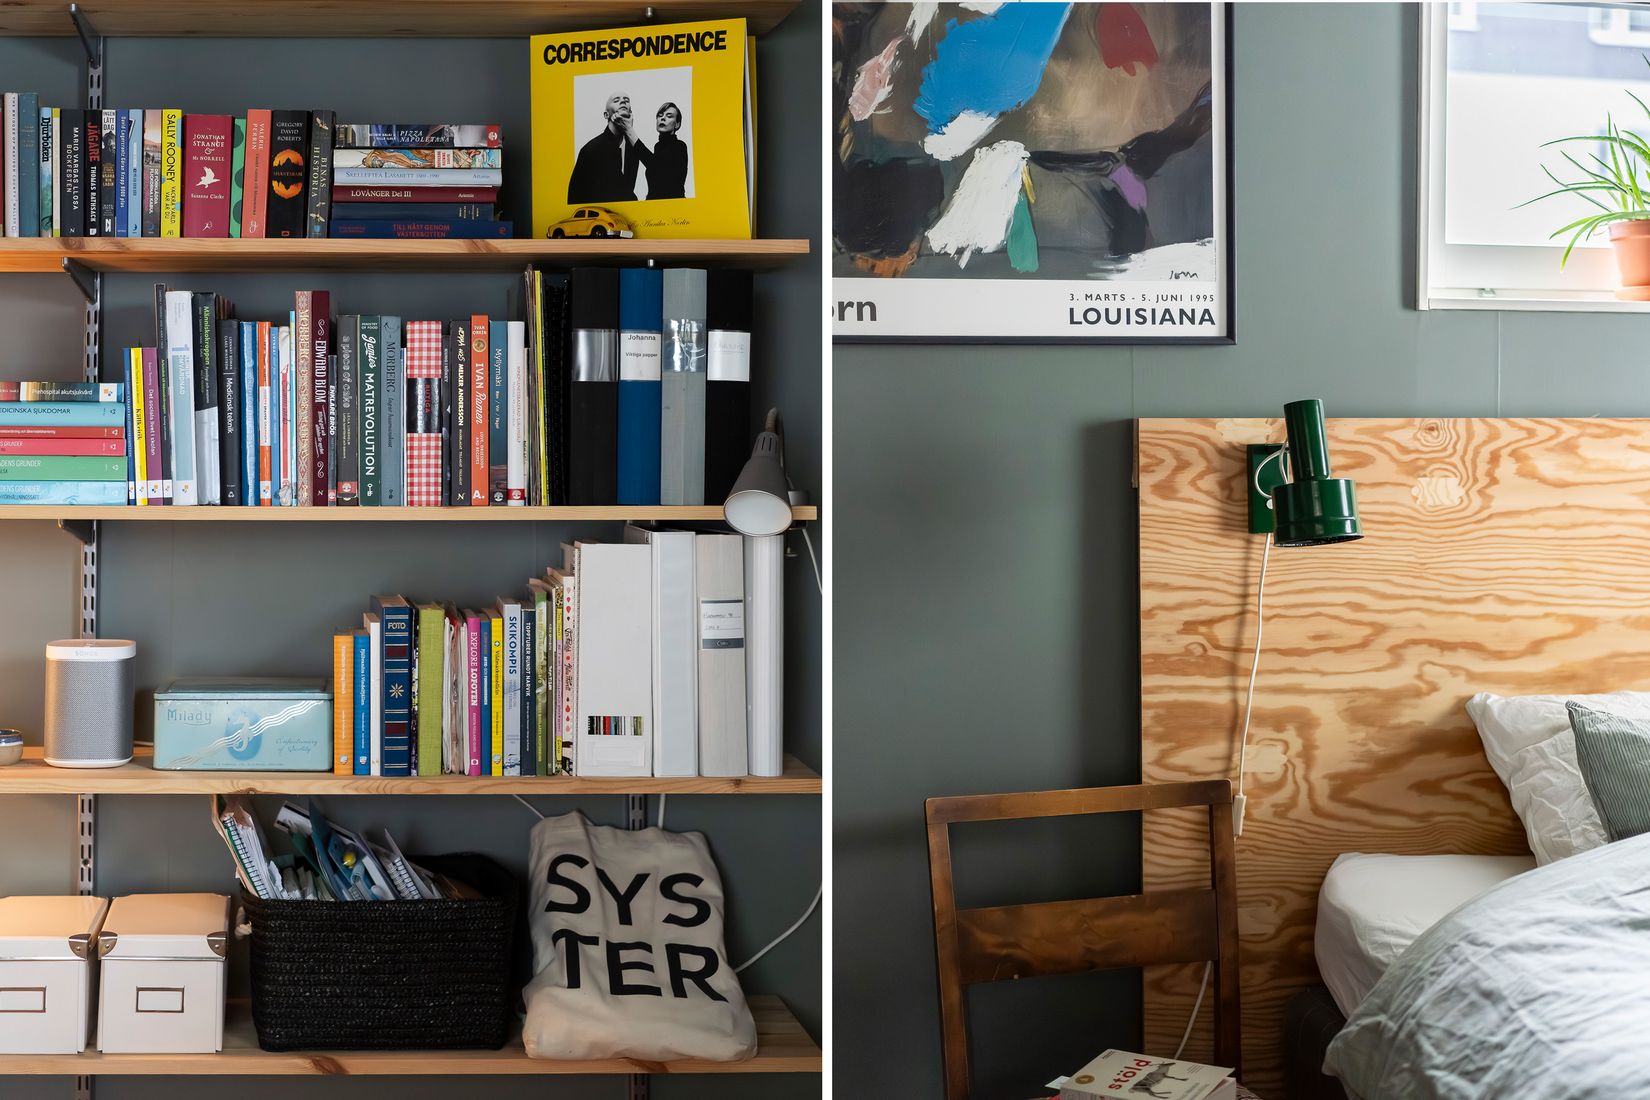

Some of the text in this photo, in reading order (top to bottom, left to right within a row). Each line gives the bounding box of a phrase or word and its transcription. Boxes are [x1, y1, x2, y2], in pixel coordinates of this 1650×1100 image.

[543, 30, 727, 65] CORRESPONDENCE
[41, 116, 52, 163] Djurboken
[87, 121, 101, 162] JÄGARE
[165, 113, 176, 183] SALLY ROONEY
[72, 126, 80, 210] MARIO VARGAS LLOSA
[311, 146, 321, 198] HISTORIA
[319, 157, 328, 188] BINAS
[351, 189, 391, 198] LÖVÅNGER
[392, 190, 402, 198] Del
[424, 223, 450, 232] GENOM
[1069, 293, 1080, 302] 3.
[1085, 293, 1126, 302] MARTS
[1141, 293, 1151, 302] 5.
[1155, 294, 1184, 303] JUNI
[1189, 294, 1215, 302] 1995
[1069, 307, 1216, 326] LOUISIANA
[203, 306, 211, 365] Människokroppen
[315, 340, 327, 404] EDWARD BLOM
[341, 344, 353, 371] piece
[386, 341, 397, 393] MORBERG
[494, 348, 503, 387] Myllymäki
[342, 372, 353, 383] of
[475, 362, 485, 389] IVAN
[33, 407, 71, 415] SJUKDOMAR
[342, 384, 353, 409] cake
[424, 384, 432, 414] RUTIGA
[475, 390, 488, 425] Ramen
[135, 408, 143, 441] Källkritik
[329, 416, 337, 436] BRÖD
[364, 373, 376, 476] MATREVOLUTION
[388, 622, 407, 630] FOTO
[509, 616, 518, 675] SKIKOMPIS
[167, 708, 212, 724] Milady
[544, 853, 712, 928] SYS
[551, 928, 729, 1003] TER
[1108, 1058, 1152, 1090] stöld
